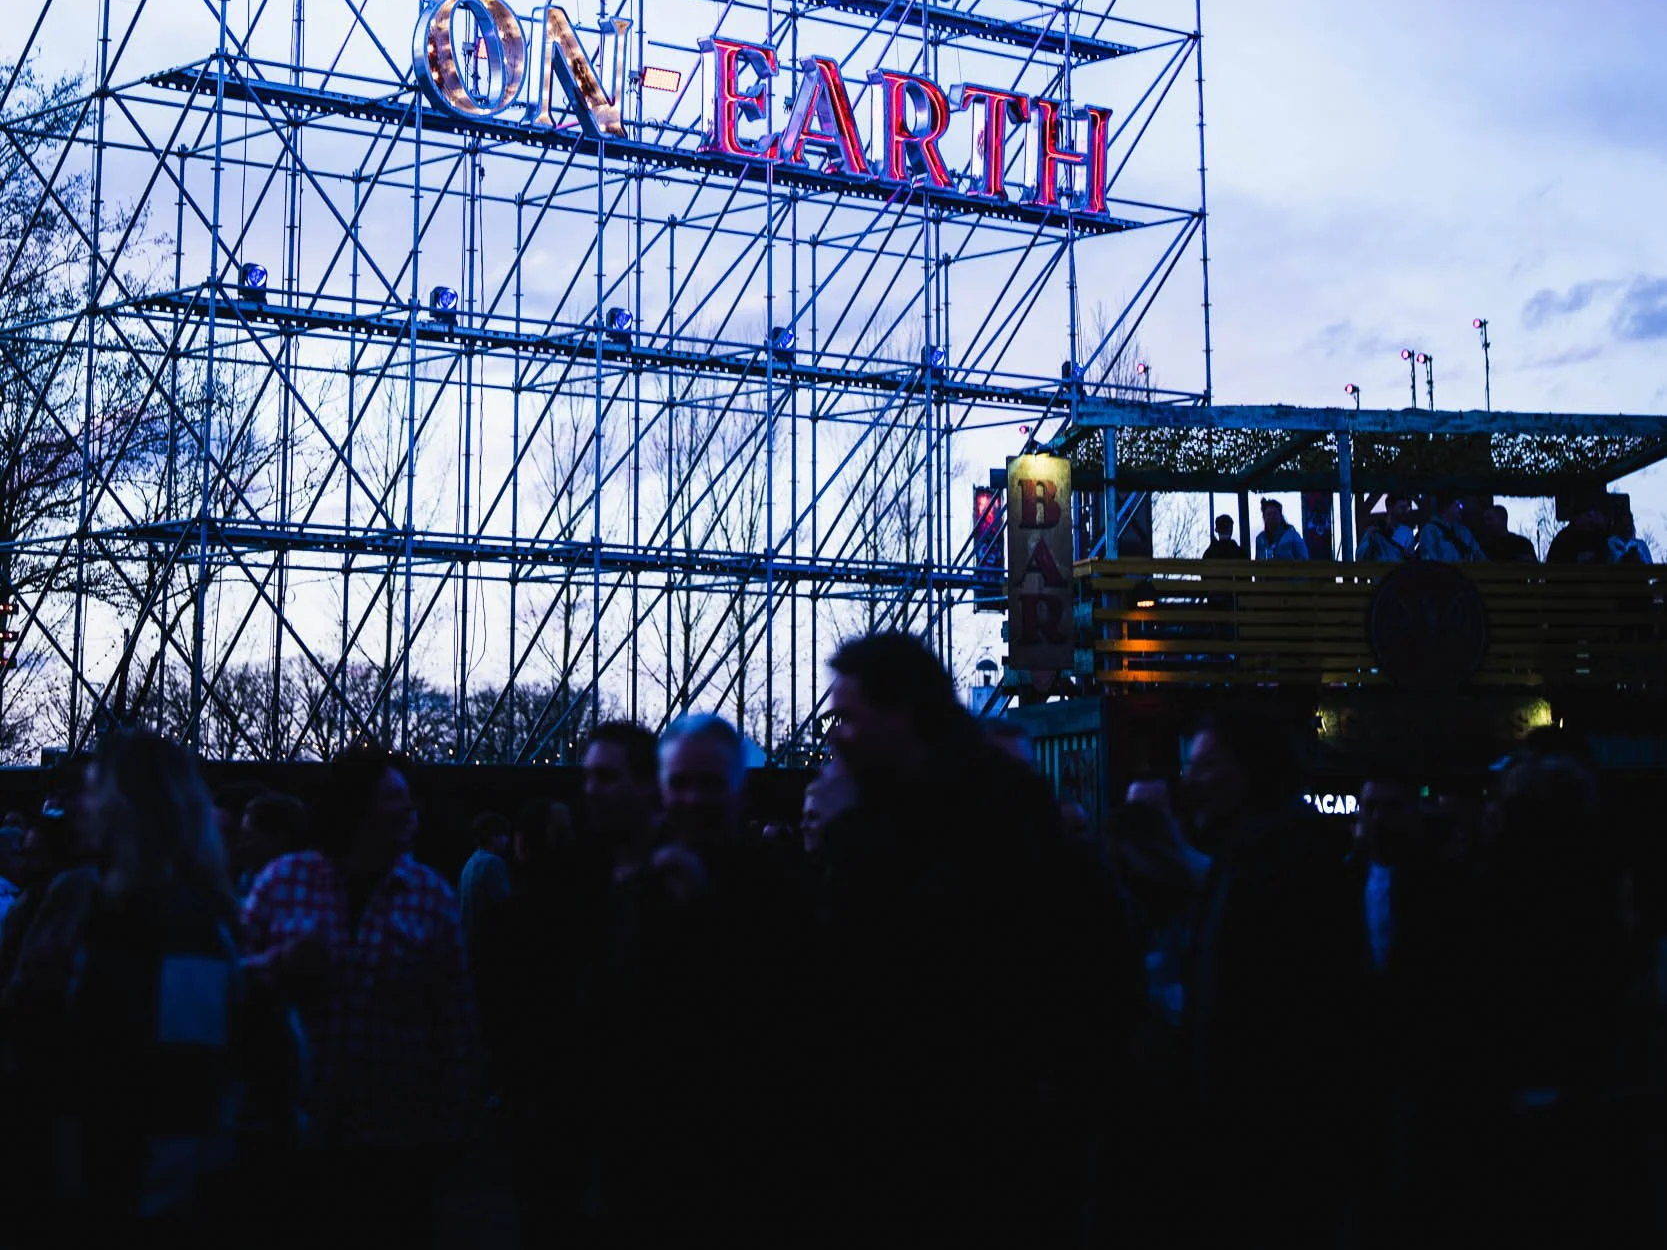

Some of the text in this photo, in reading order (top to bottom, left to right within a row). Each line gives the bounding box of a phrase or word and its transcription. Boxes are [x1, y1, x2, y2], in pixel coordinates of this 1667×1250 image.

[696, 36, 1113, 215] EARTH
[1017, 478, 1068, 645] BAR
[1303, 793, 1360, 814] ACAR
